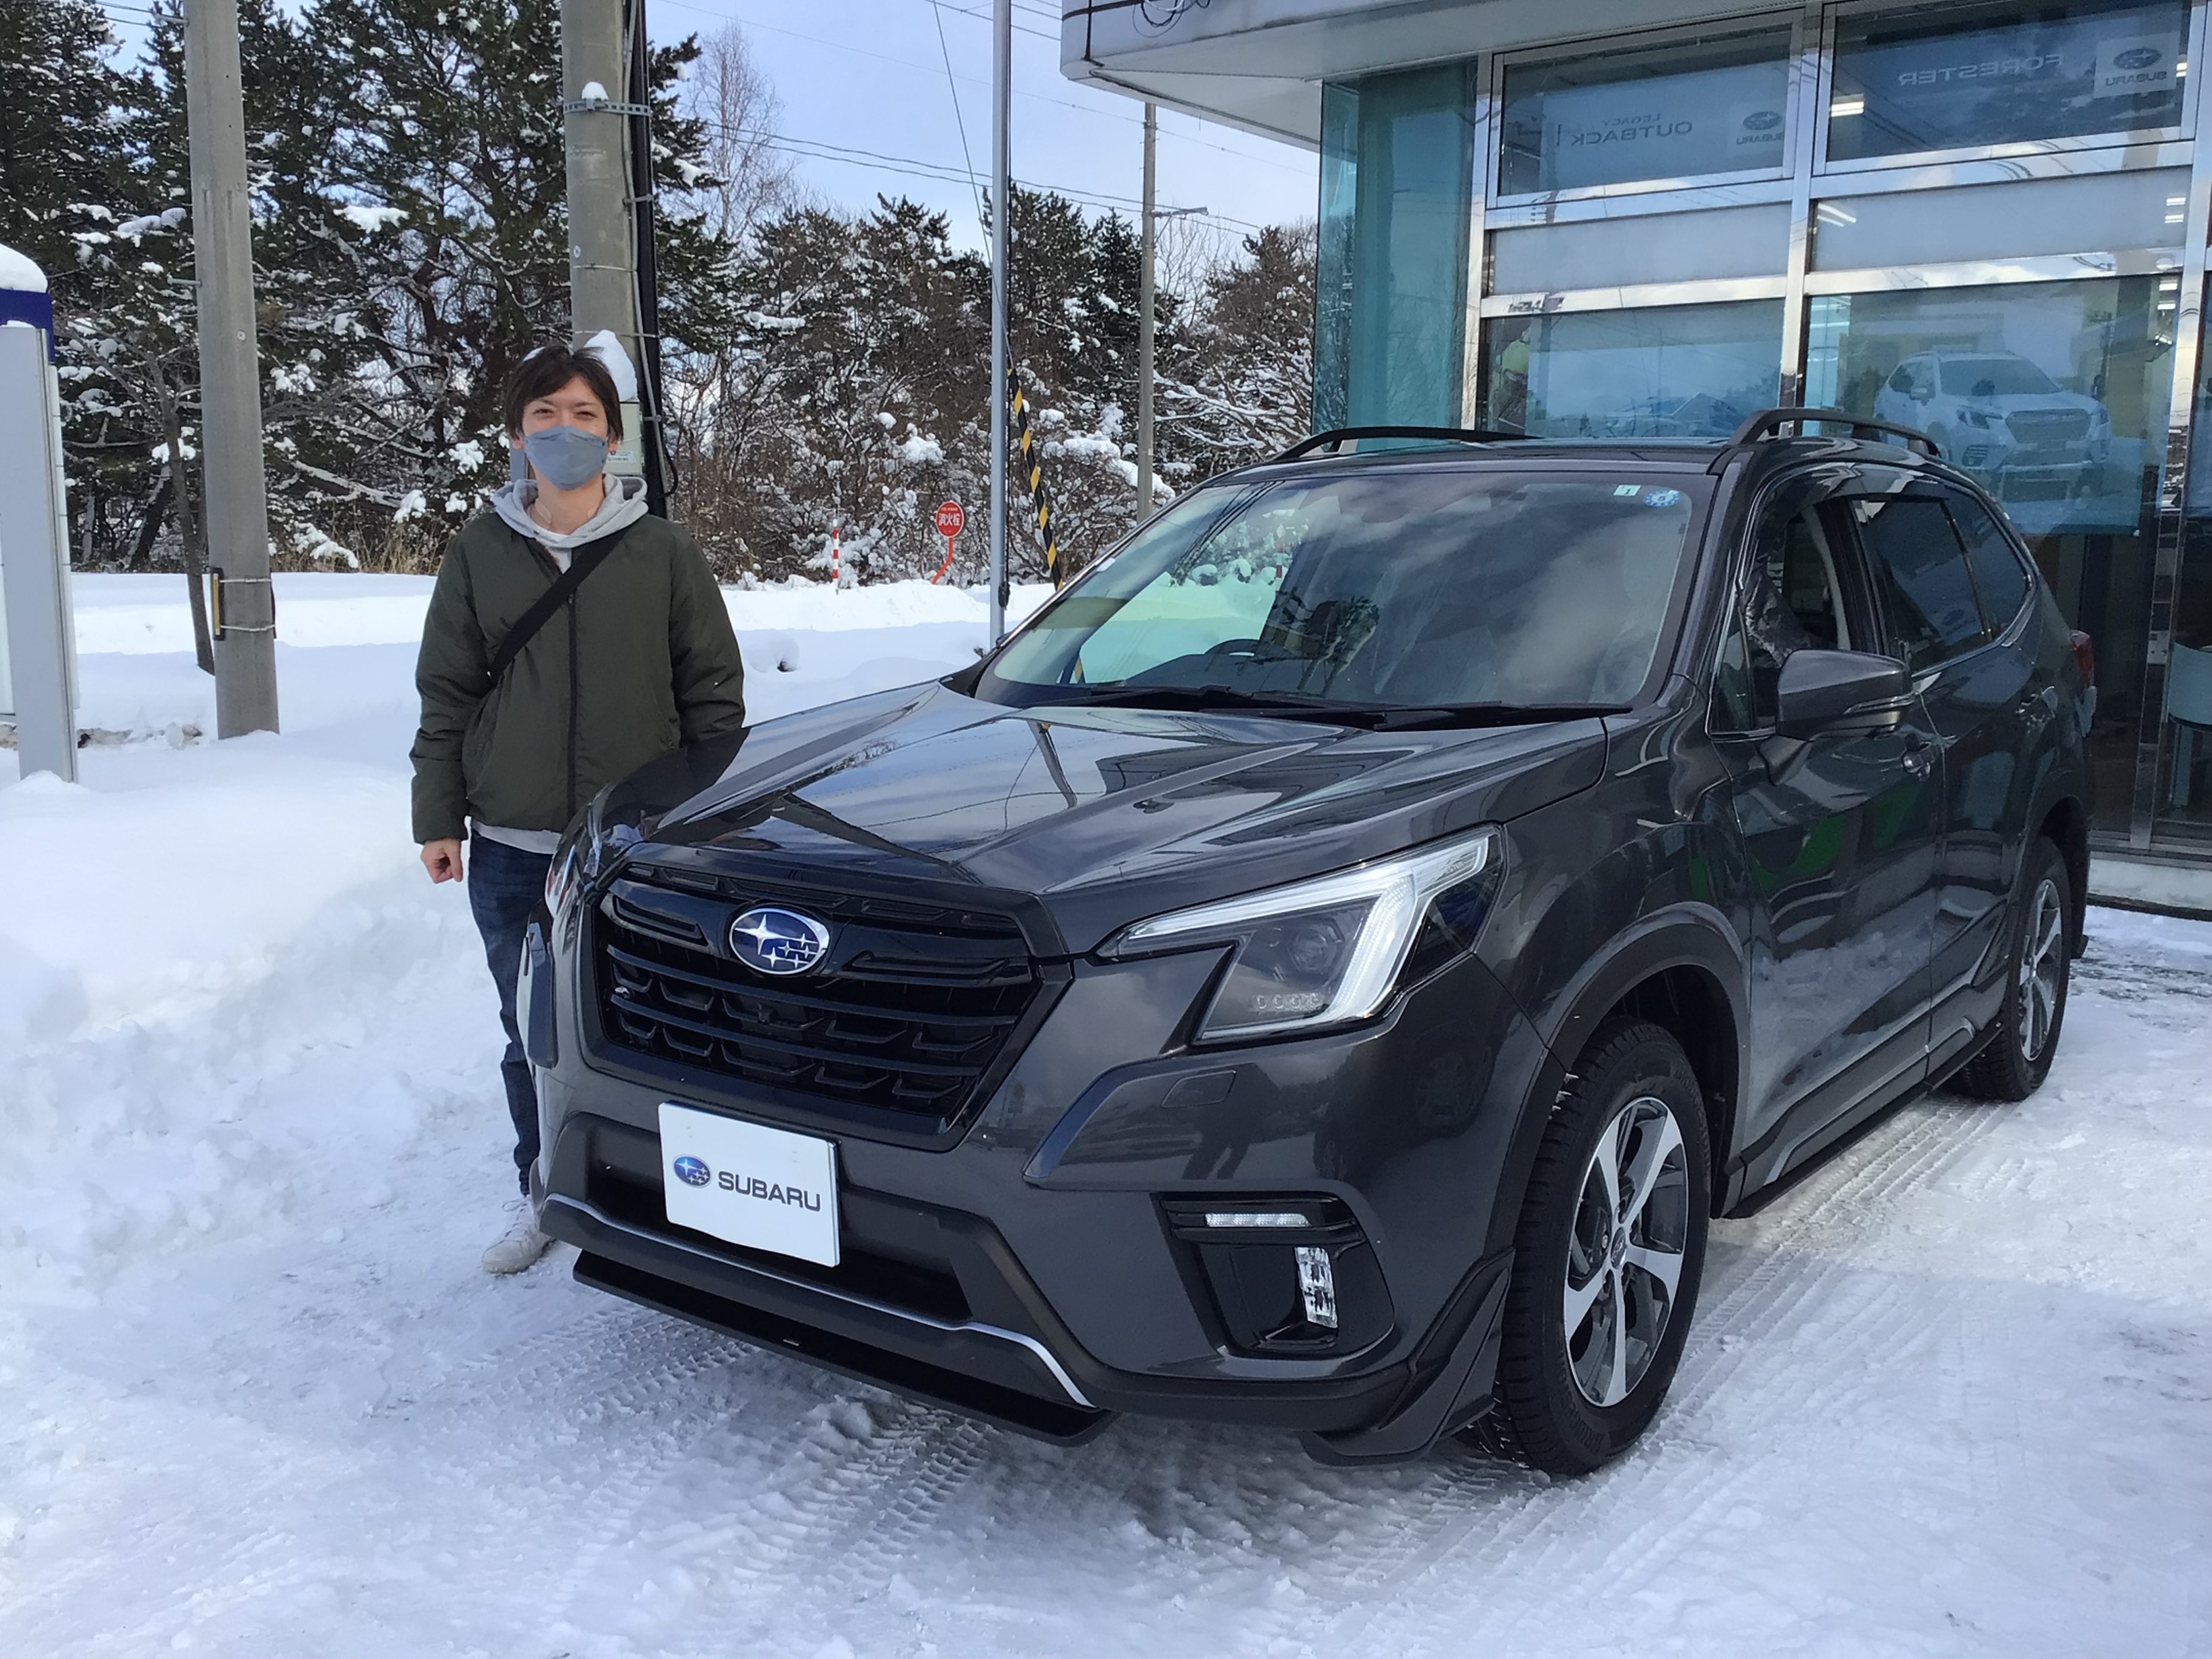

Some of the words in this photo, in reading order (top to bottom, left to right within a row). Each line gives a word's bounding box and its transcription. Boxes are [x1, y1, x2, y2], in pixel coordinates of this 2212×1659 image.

[939, 513, 960, 526] 消火栓
[718, 1170, 821, 1212] SUBARU
